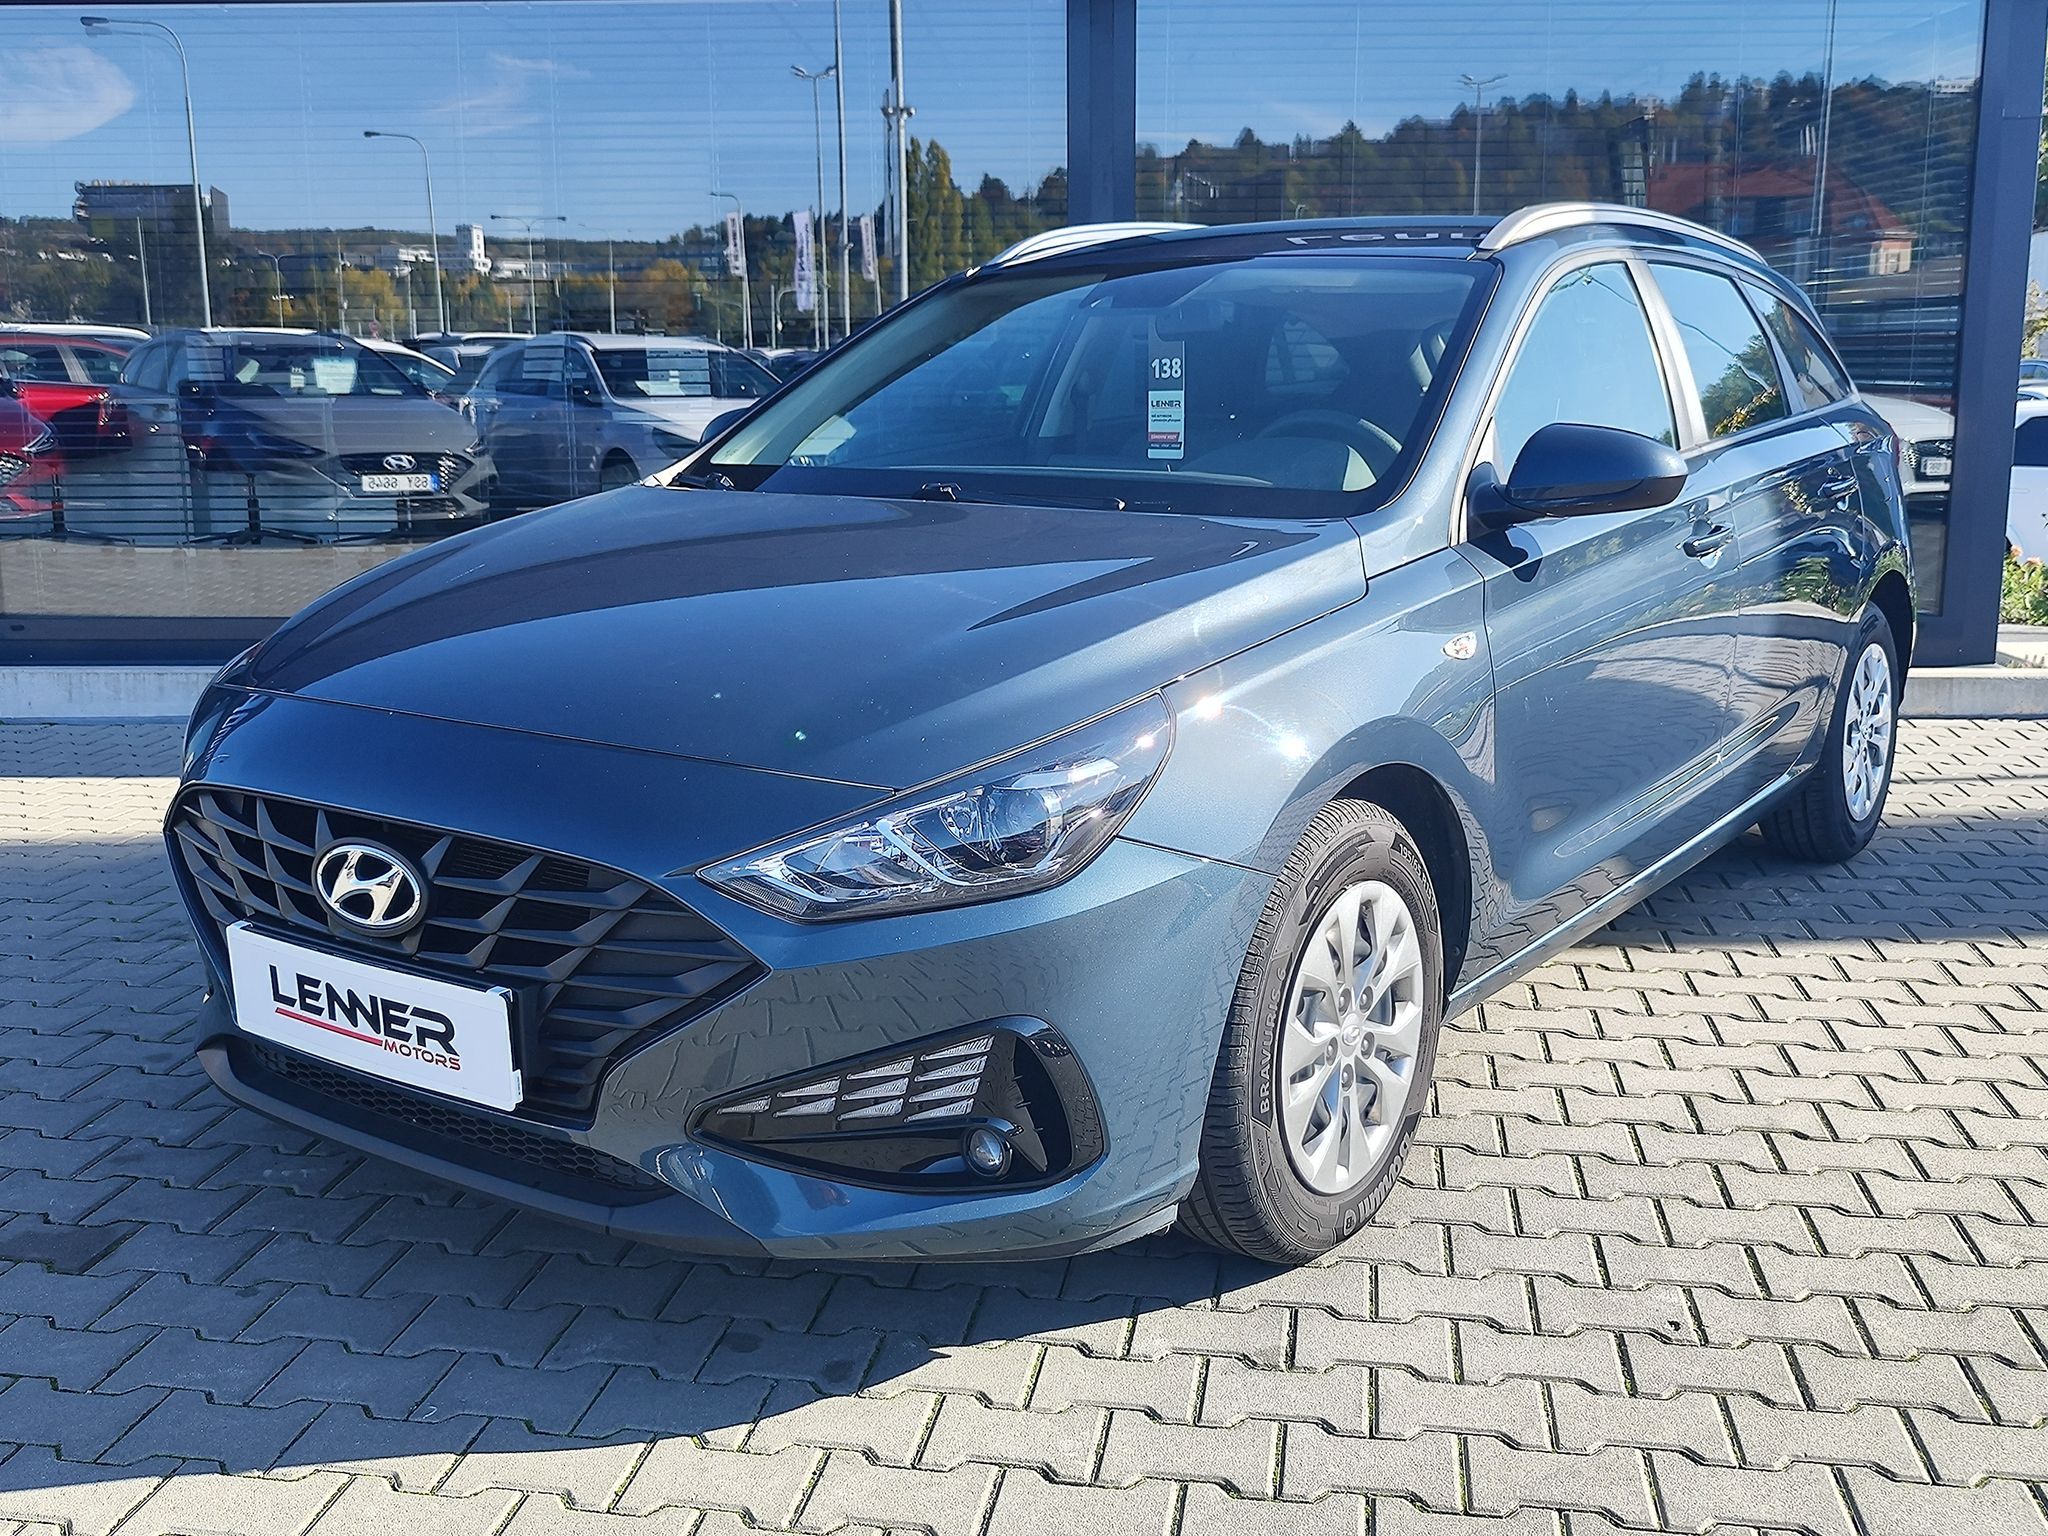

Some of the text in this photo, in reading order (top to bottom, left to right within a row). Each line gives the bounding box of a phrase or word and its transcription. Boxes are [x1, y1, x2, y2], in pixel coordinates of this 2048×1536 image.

[1151, 358, 1181, 378] 138
[269, 964, 460, 1056] LENNER
[1260, 967, 1286, 1114] BRAVURIS 6
[384, 1039, 461, 1071] MOTORS
